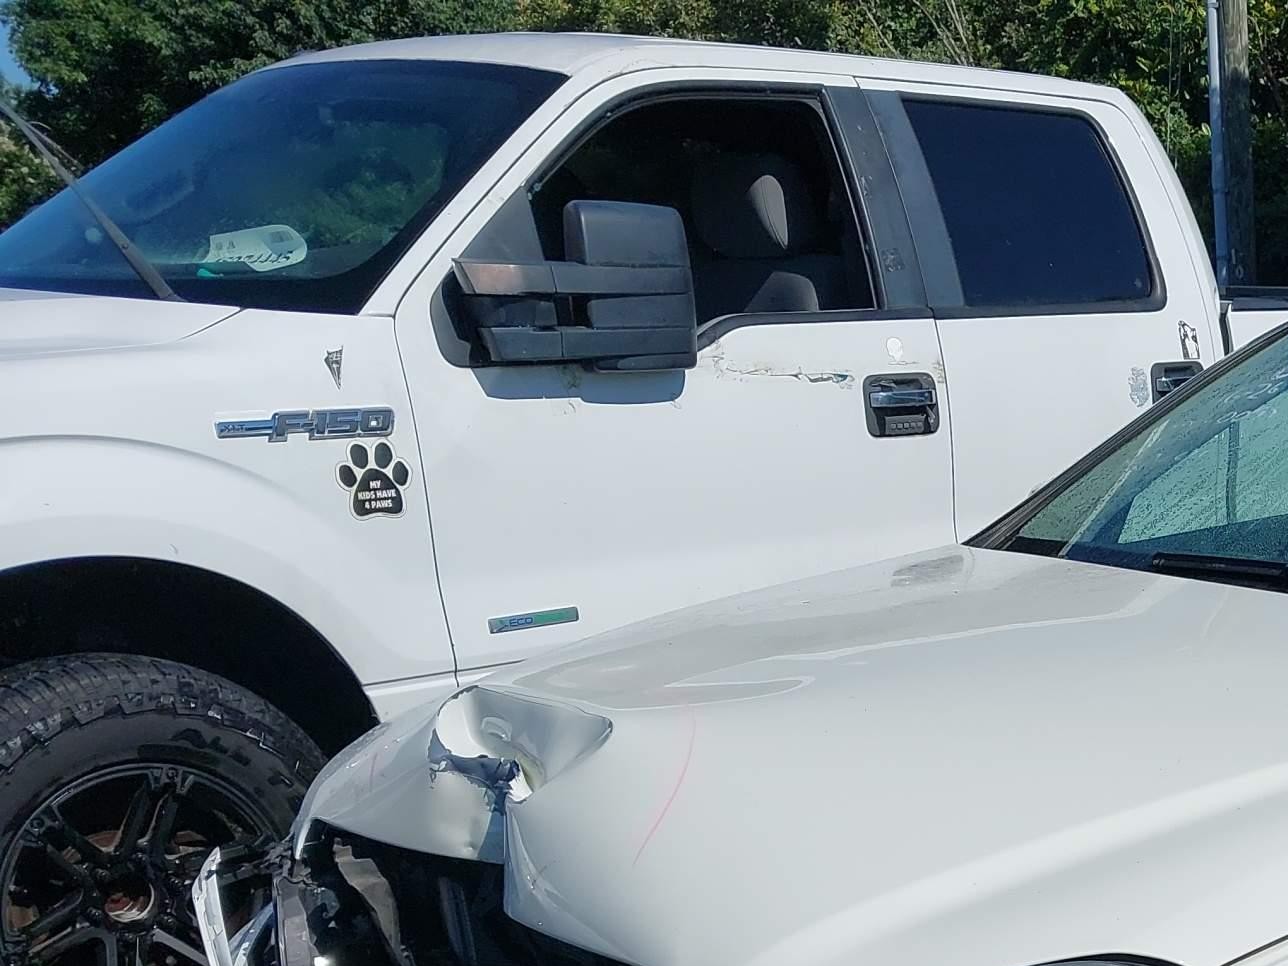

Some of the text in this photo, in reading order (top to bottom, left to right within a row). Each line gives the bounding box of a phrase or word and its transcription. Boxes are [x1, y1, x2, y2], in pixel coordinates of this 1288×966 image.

[268, 407, 395, 443] F-150
[369, 480, 382, 489] MY
[357, 489, 397, 500] KIDS HAVE
[364, 499, 393, 509] 4 PAWS
